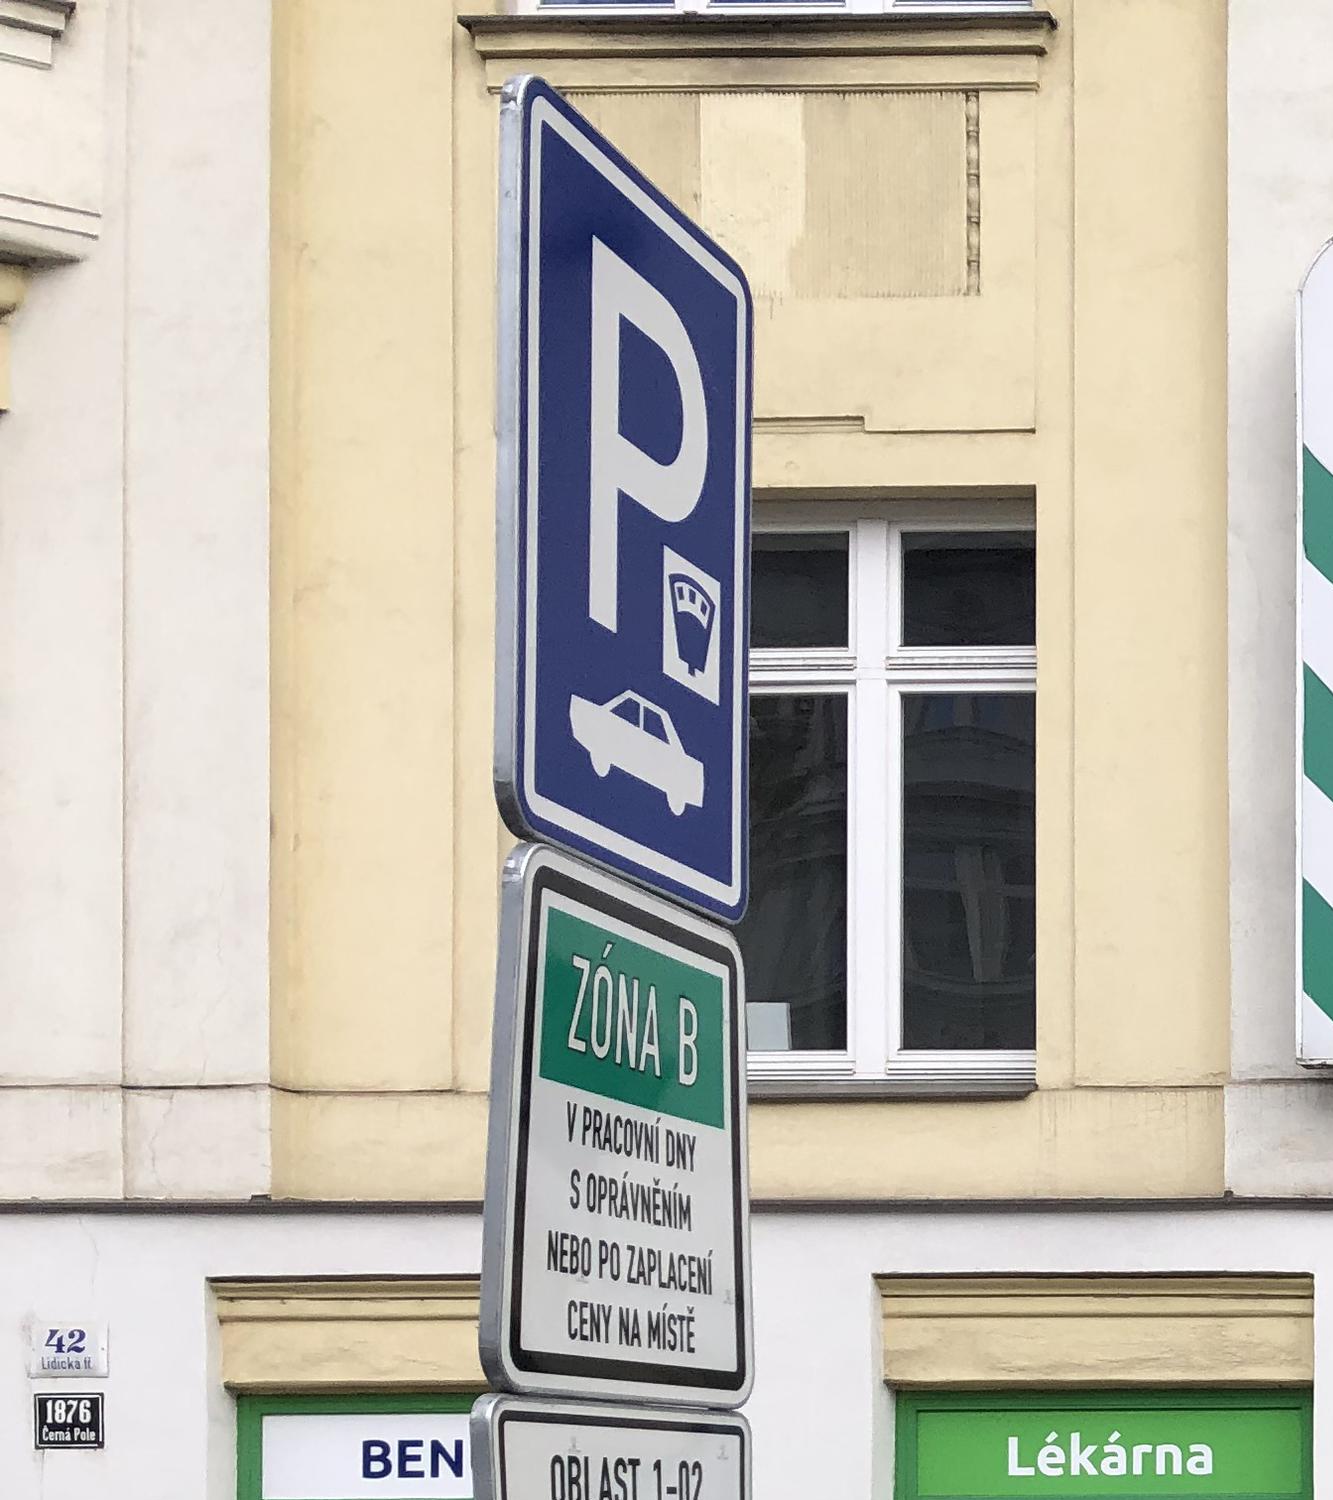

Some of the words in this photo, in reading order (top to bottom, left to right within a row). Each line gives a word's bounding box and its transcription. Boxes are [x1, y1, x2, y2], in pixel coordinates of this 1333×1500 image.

[588, 234, 708, 634] P
[567, 944, 661, 1078] ZÓNA
[677, 995, 699, 1087] B
[566, 1101, 577, 1144] V
[582, 1104, 661, 1163] PRACOVNÍ
[665, 1131, 696, 1172] DNY
[569, 1169, 580, 1207] S
[587, 1171, 691, 1232] OPRÁVNĚNÍM
[546, 1230, 591, 1278] NEBO
[598, 1243, 621, 1283] PO
[626, 1246, 713, 1296] ZAPLACENÍ
[45, 1329, 86, 1353] 42
[567, 1306, 610, 1345] CENY
[617, 1313, 642, 1348] NA
[647, 1301, 696, 1354] MÍSTĚ
[42, 1425, 71, 1442] Černá
[73, 1427, 96, 1442] Pole
[46, 1399, 91, 1423] 1876
[361, 1439, 464, 1479] BEN
[1007, 1431, 1213, 1477] Lékárna
